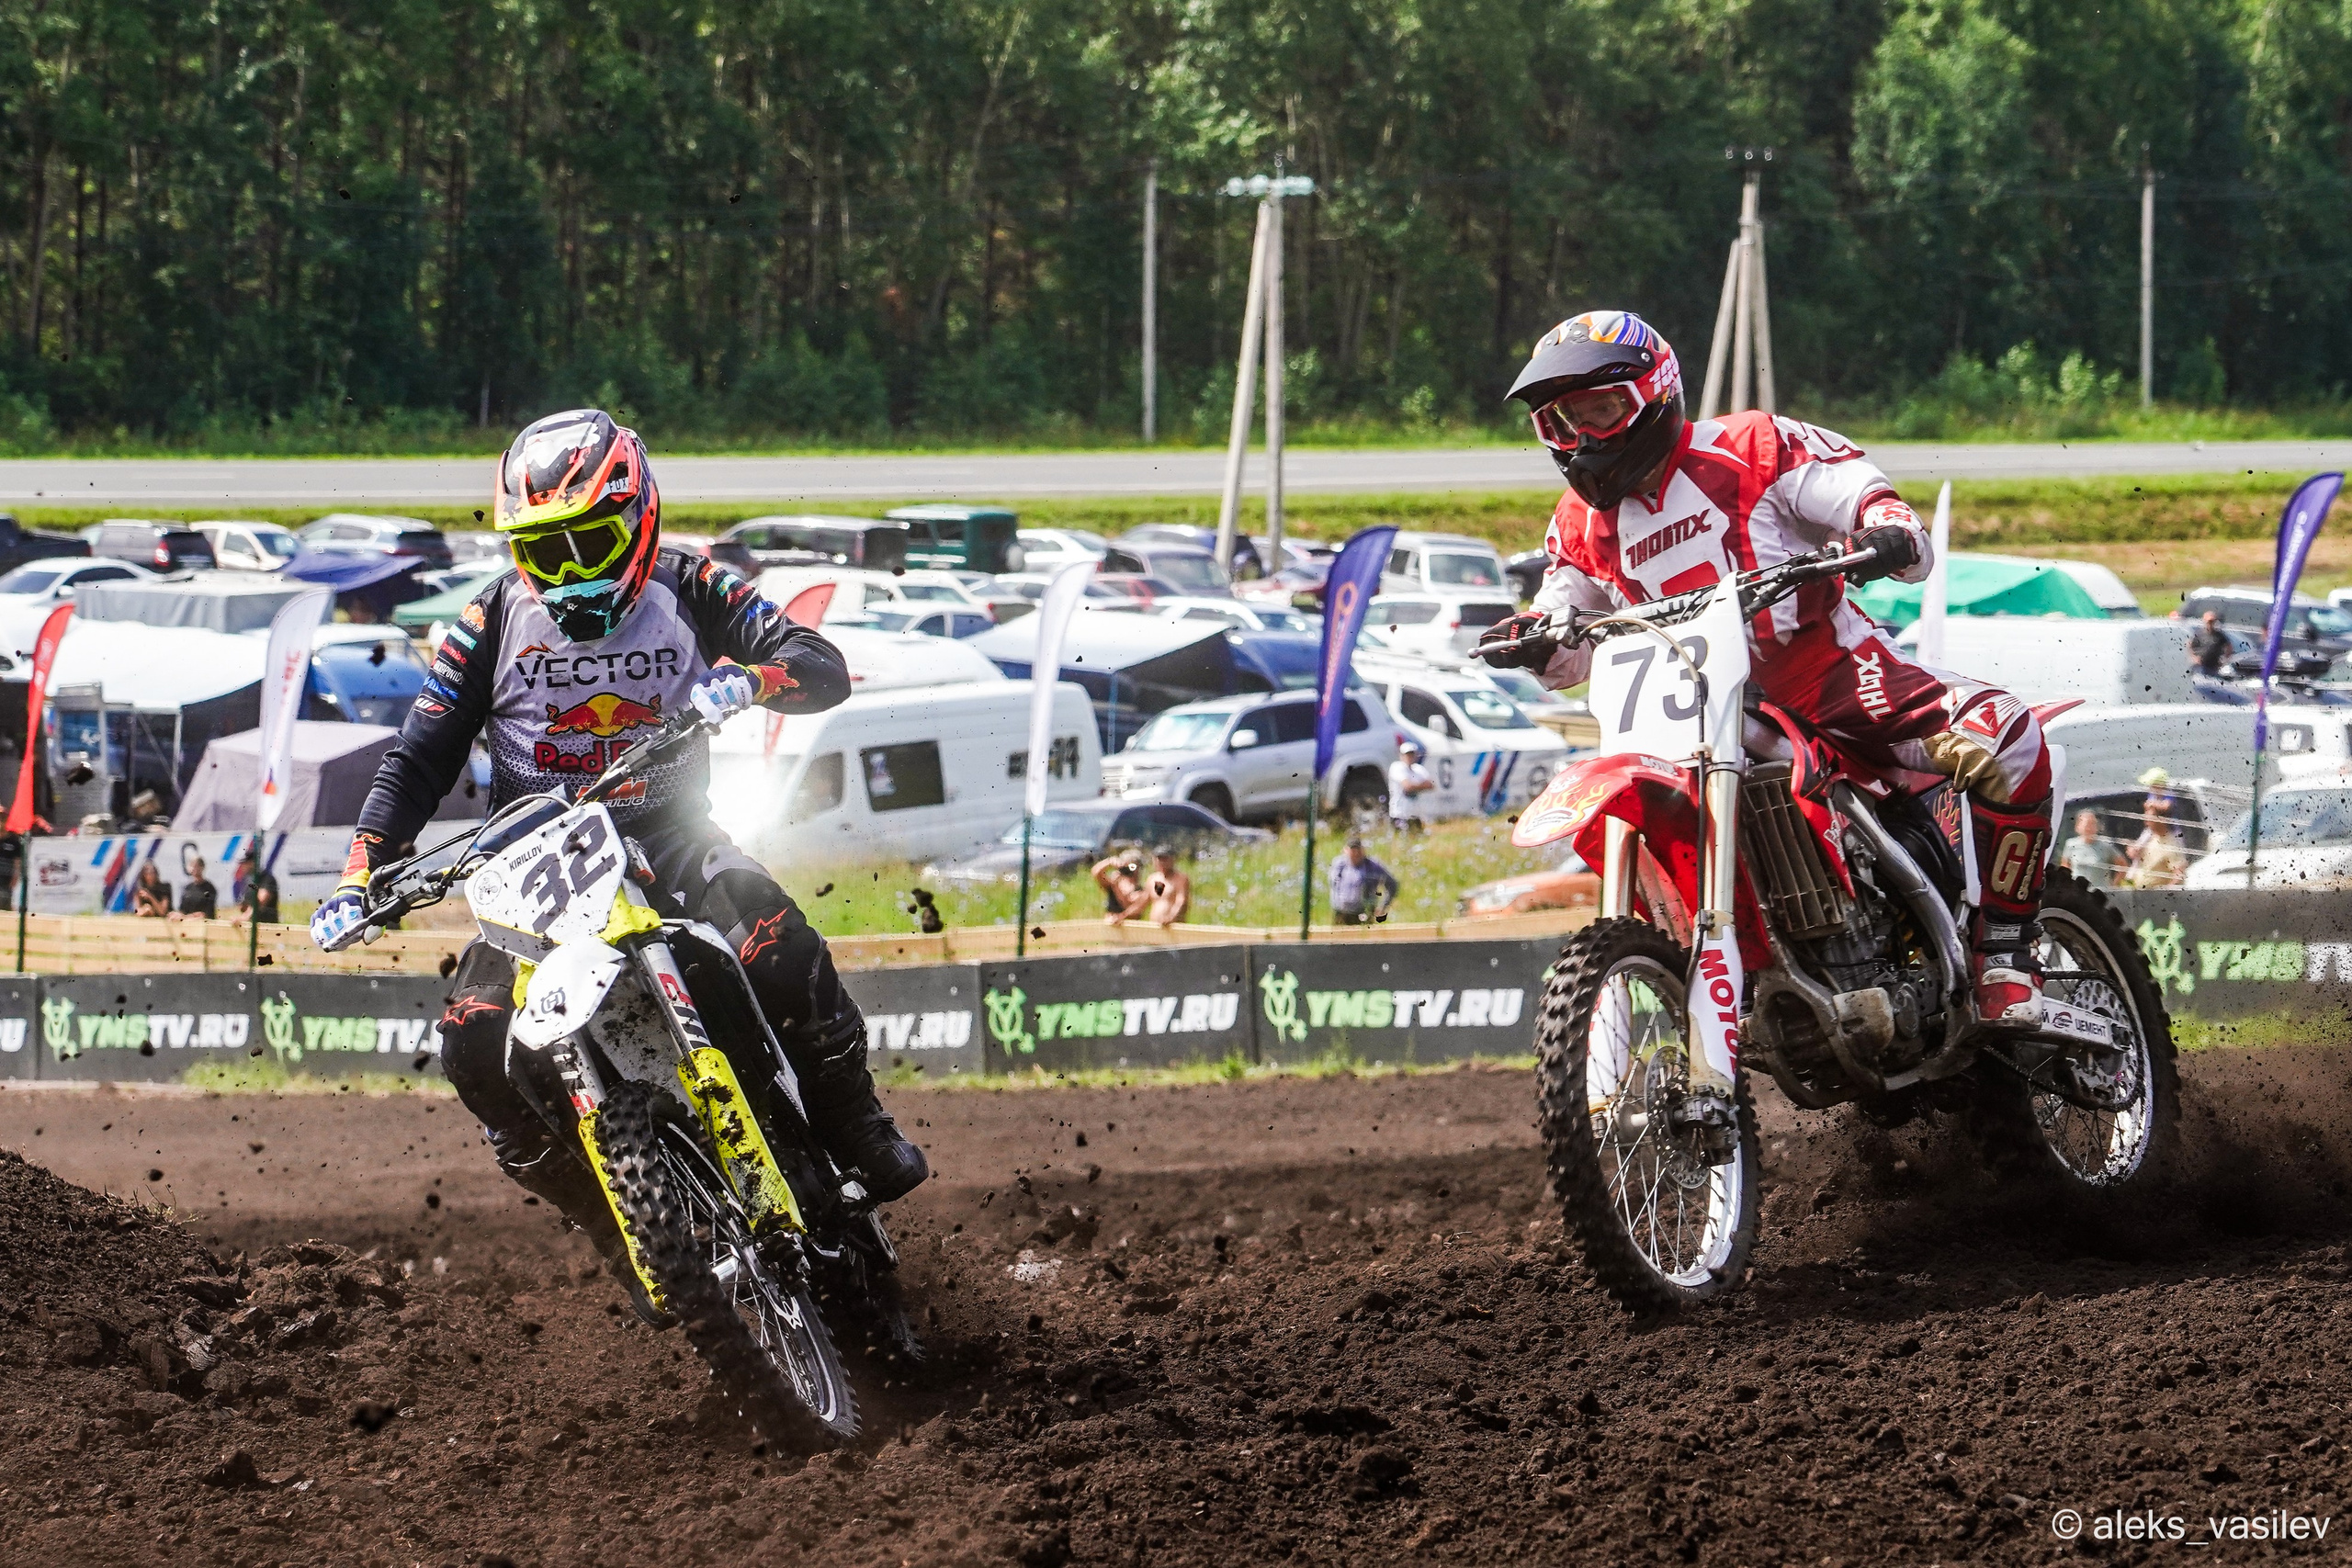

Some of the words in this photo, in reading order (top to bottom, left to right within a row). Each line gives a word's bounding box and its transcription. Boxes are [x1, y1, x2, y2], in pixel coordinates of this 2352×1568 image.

[609, 478, 628, 492] FOX
[514, 648, 680, 690] VECTOR
[1611, 636, 1709, 734] 73
[415, 697, 446, 712] WP
[534, 740, 606, 773] Red
[508, 843, 544, 872] KIRILLOV
[520, 814, 618, 934] 32
[1991, 830, 2029, 896] G
[2197, 941, 2352, 983] YMST
[1035, 992, 1239, 1041] YMSTV.RU
[1306, 987, 1525, 1028] YMSTV.RU
[77, 1013, 251, 1049] YMSTV.RU
[301, 1016, 444, 1054] YMSTV.
[865, 1010, 973, 1050] TV.RU
